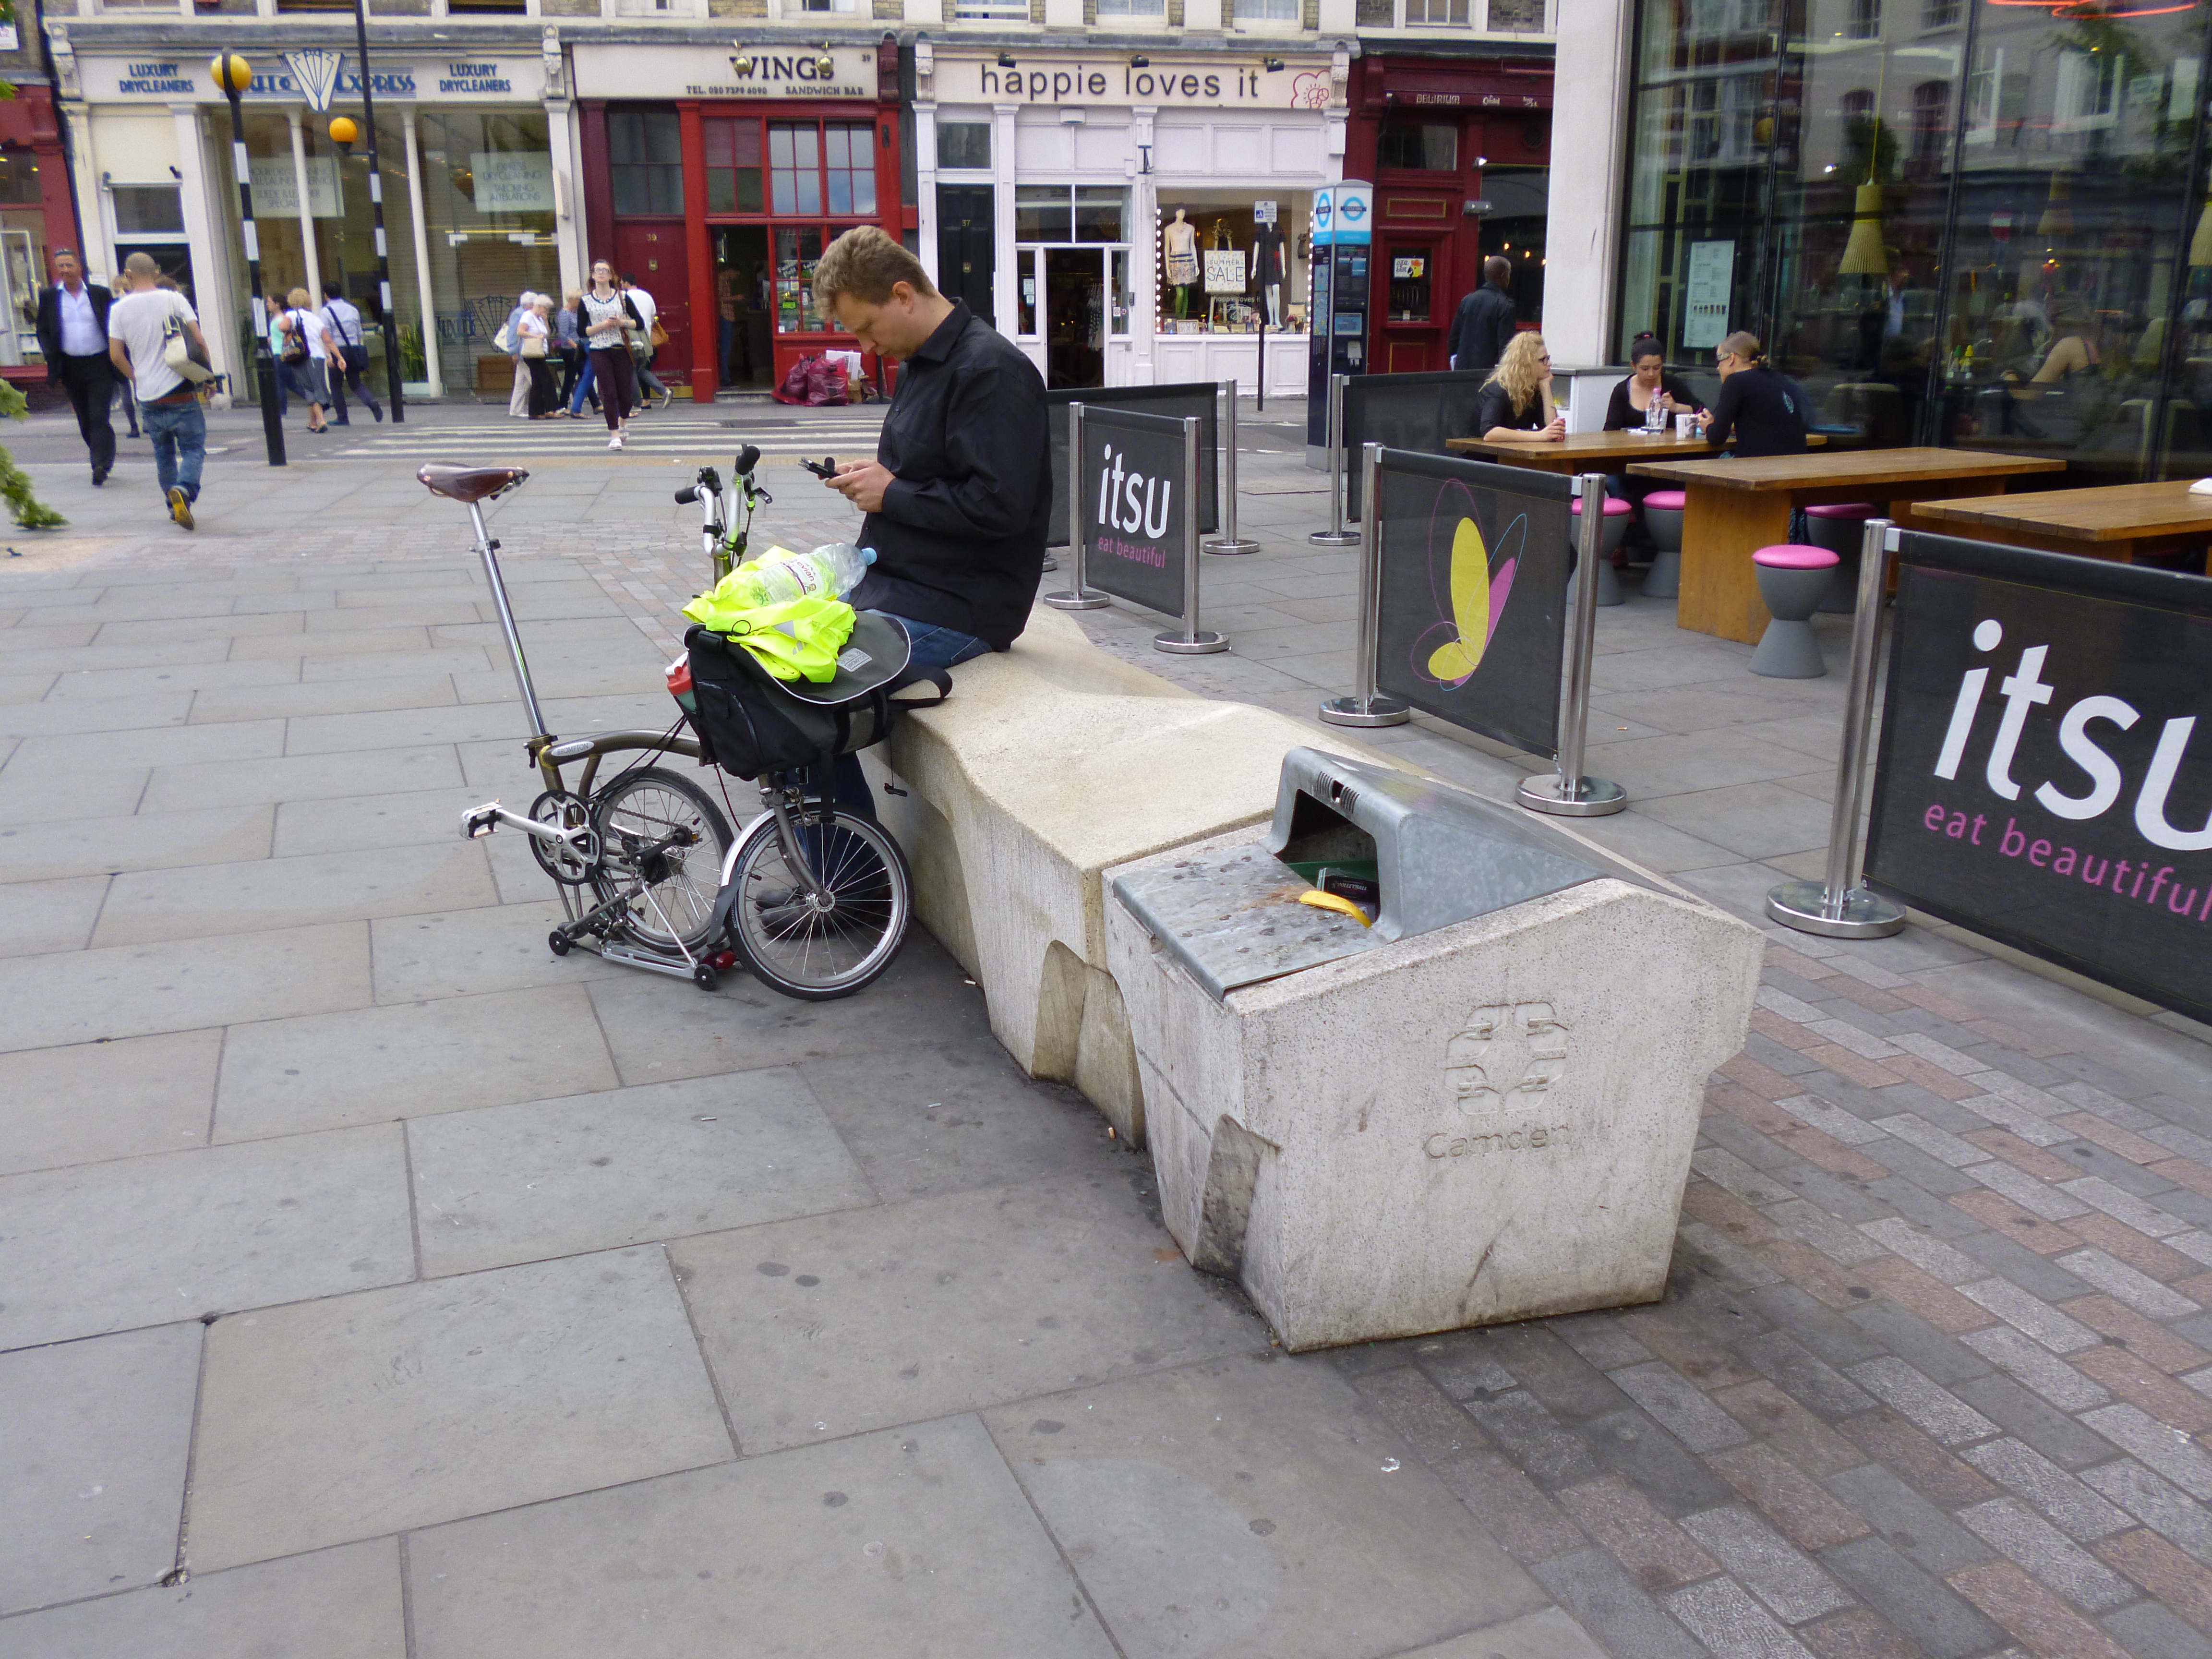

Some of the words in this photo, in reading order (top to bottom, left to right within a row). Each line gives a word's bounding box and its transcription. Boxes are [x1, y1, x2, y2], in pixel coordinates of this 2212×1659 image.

[129, 63, 178, 77] LUXURY
[449, 63, 497, 77] LUXURY
[119, 80, 194, 94] DRYCLEANERS
[439, 79, 511, 92] DRYCLEANERS
[981, 63, 1106, 101] happie
[1126, 66, 1221, 97] loves
[1239, 68, 1258, 97] it
[686, 85, 706, 94] TEL.
[785, 86, 840, 95] SANDWICH
[844, 86, 864, 96] BAR
[962, 219, 971, 227] 37
[1207, 266, 1244, 282] SALE
[1098, 444, 1171, 539] itsu
[1098, 536, 1114, 553] eat
[1117, 537, 1166, 568] beautiful
[797, 562, 815, 581] evian
[1934, 619, 2212, 851] itsu
[557, 743, 589, 755] BROMPTON
[1924, 804, 1987, 846] eat
[2000, 818, 2212, 922] beautiful
